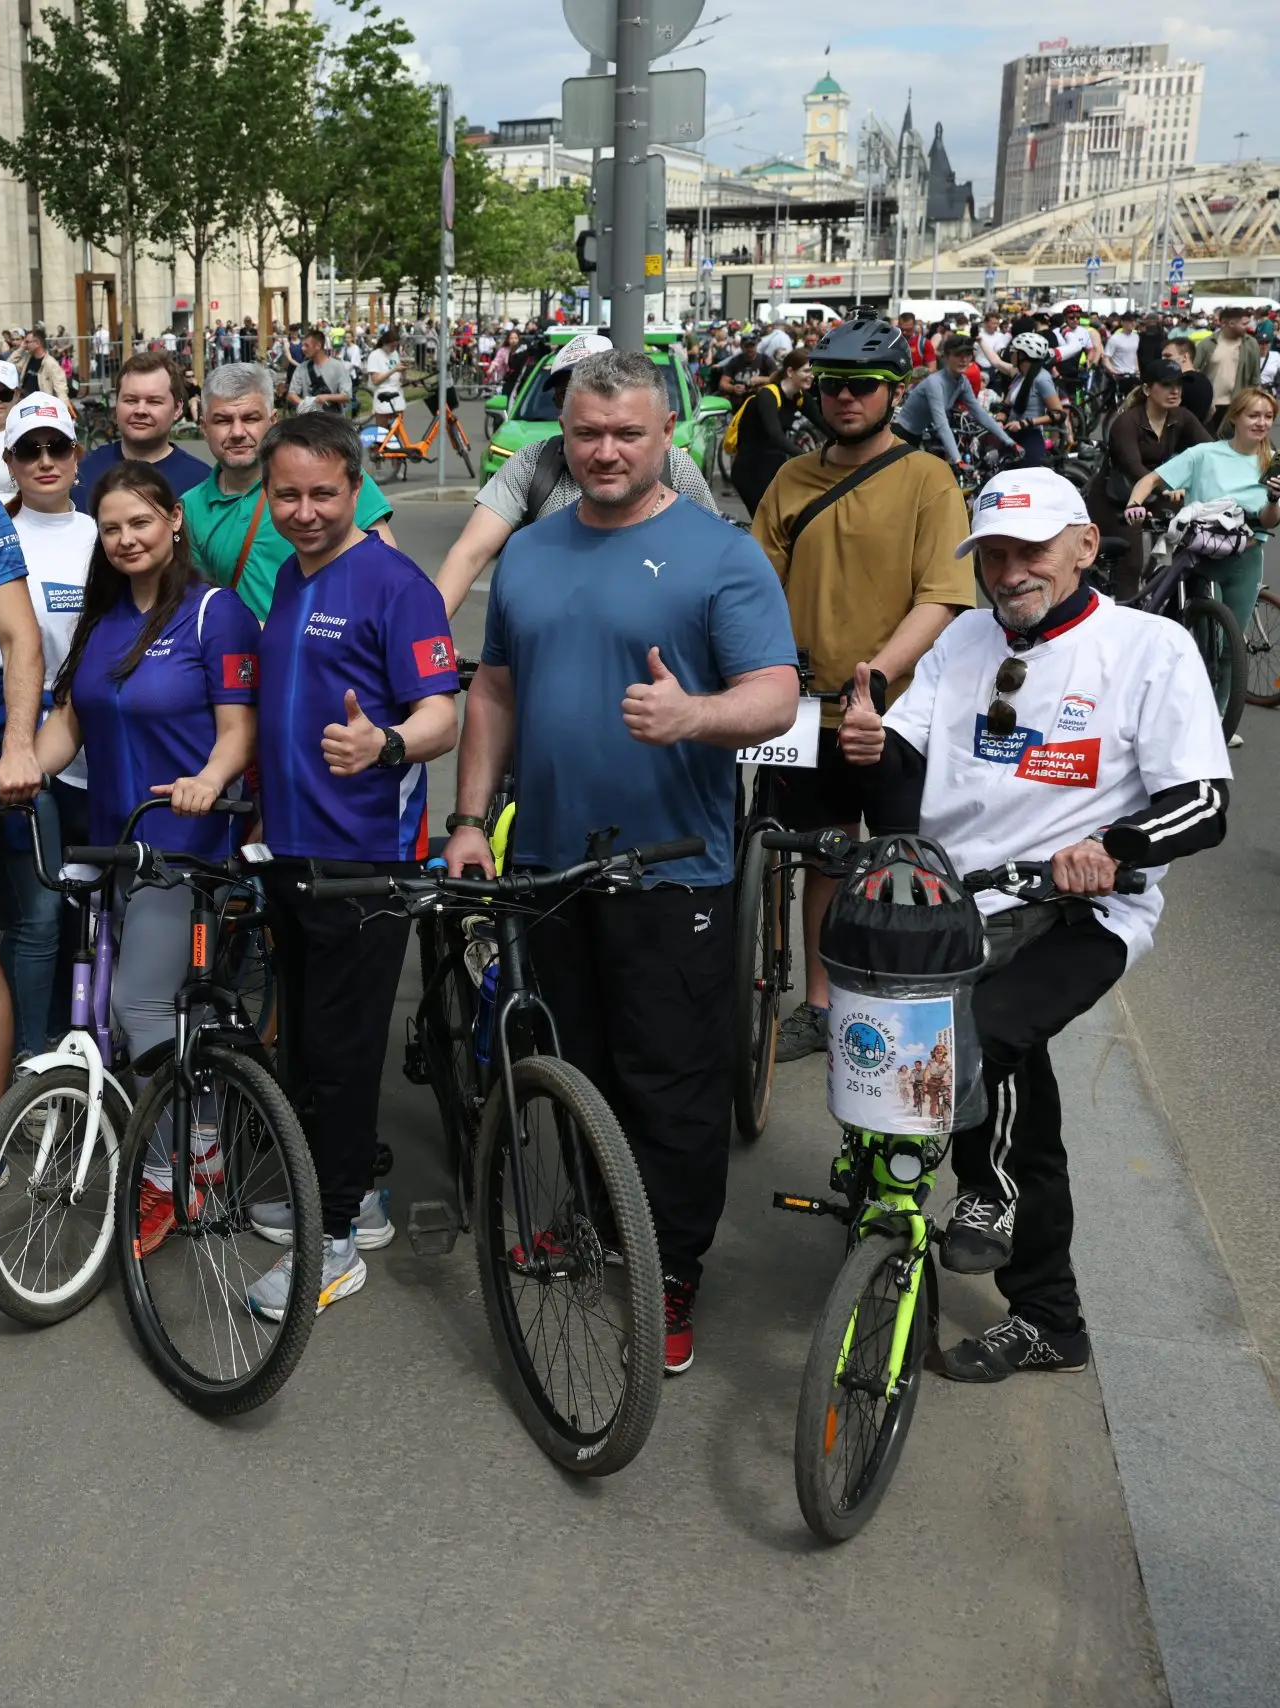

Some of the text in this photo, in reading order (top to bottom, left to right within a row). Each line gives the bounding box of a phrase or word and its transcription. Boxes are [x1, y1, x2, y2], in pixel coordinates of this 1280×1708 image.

[1050, 53, 1131, 69] SEZAR GROUP
[309, 612, 347, 626] Единая
[304, 624, 343, 640] Россия
[145, 648, 171, 657] ссия
[980, 738, 1024, 749] РОССИЯ
[738, 746, 799, 763] 17959
[979, 747, 1019, 758] СЕЙЧАС
[1030, 749, 1086, 762] ВЕЛИКАЯ
[1027, 759, 1074, 770] СТРАНА
[1024, 768, 1089, 780] НАВСЕГДА
[839, 1012, 896, 1043] МОСКОВСКИЙ
[838, 1038, 897, 1079] ВЕЛОФЕСТИВАЛЬ
[846, 1078, 882, 1098] 25136
